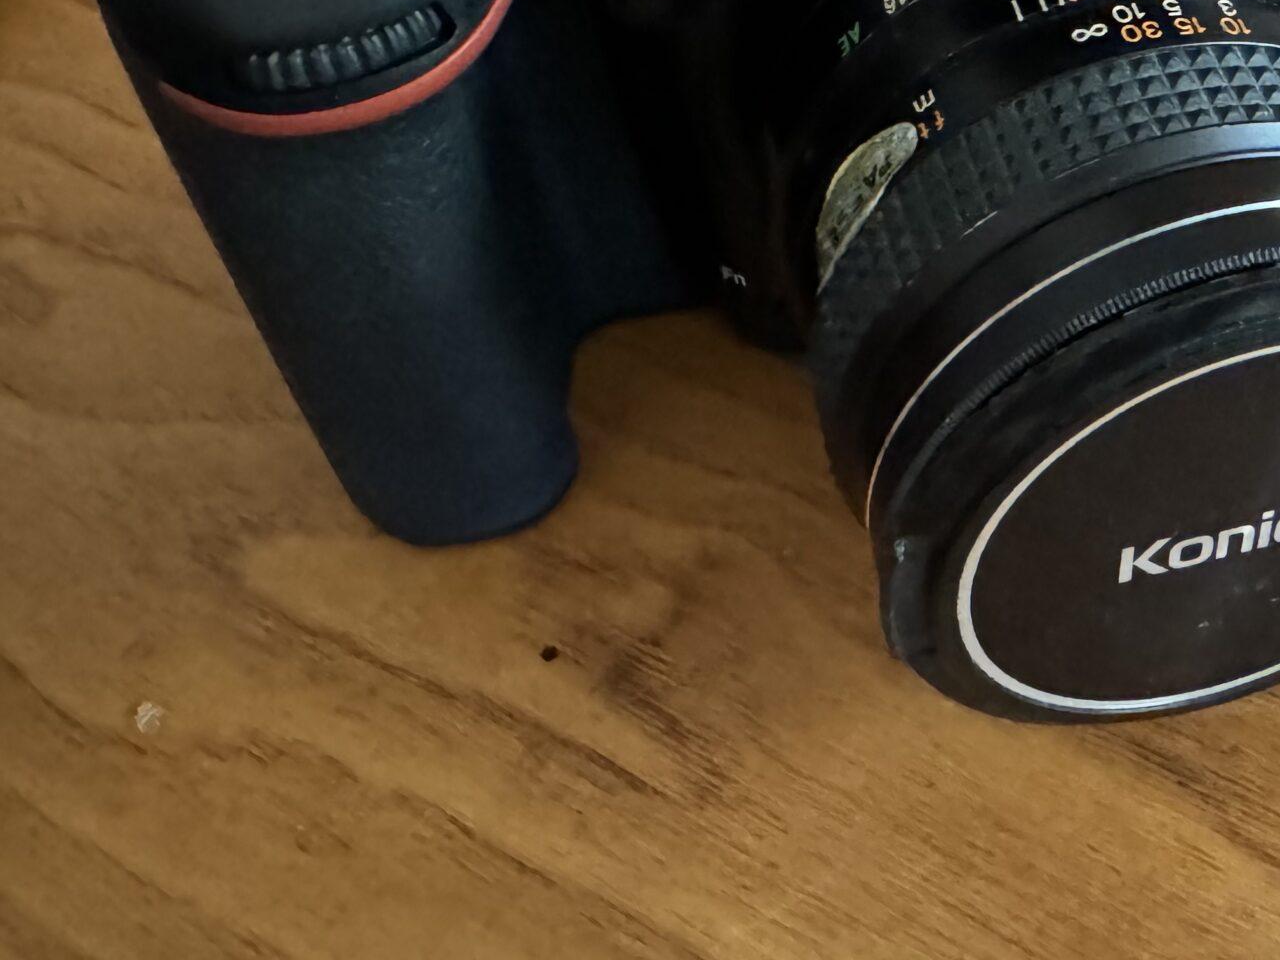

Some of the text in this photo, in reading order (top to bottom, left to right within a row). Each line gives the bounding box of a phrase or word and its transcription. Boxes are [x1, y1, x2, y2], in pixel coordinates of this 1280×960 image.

[1112, 2, 1146, 24] 10
[1217, 0, 1238, 17] 3
[1120, 20, 1163, 43] 30
[1173, 17, 1207, 36] 15
[1219, 17, 1251, 36] 10
[837, 21, 860, 57] AE
[912, 89, 936, 112] m
